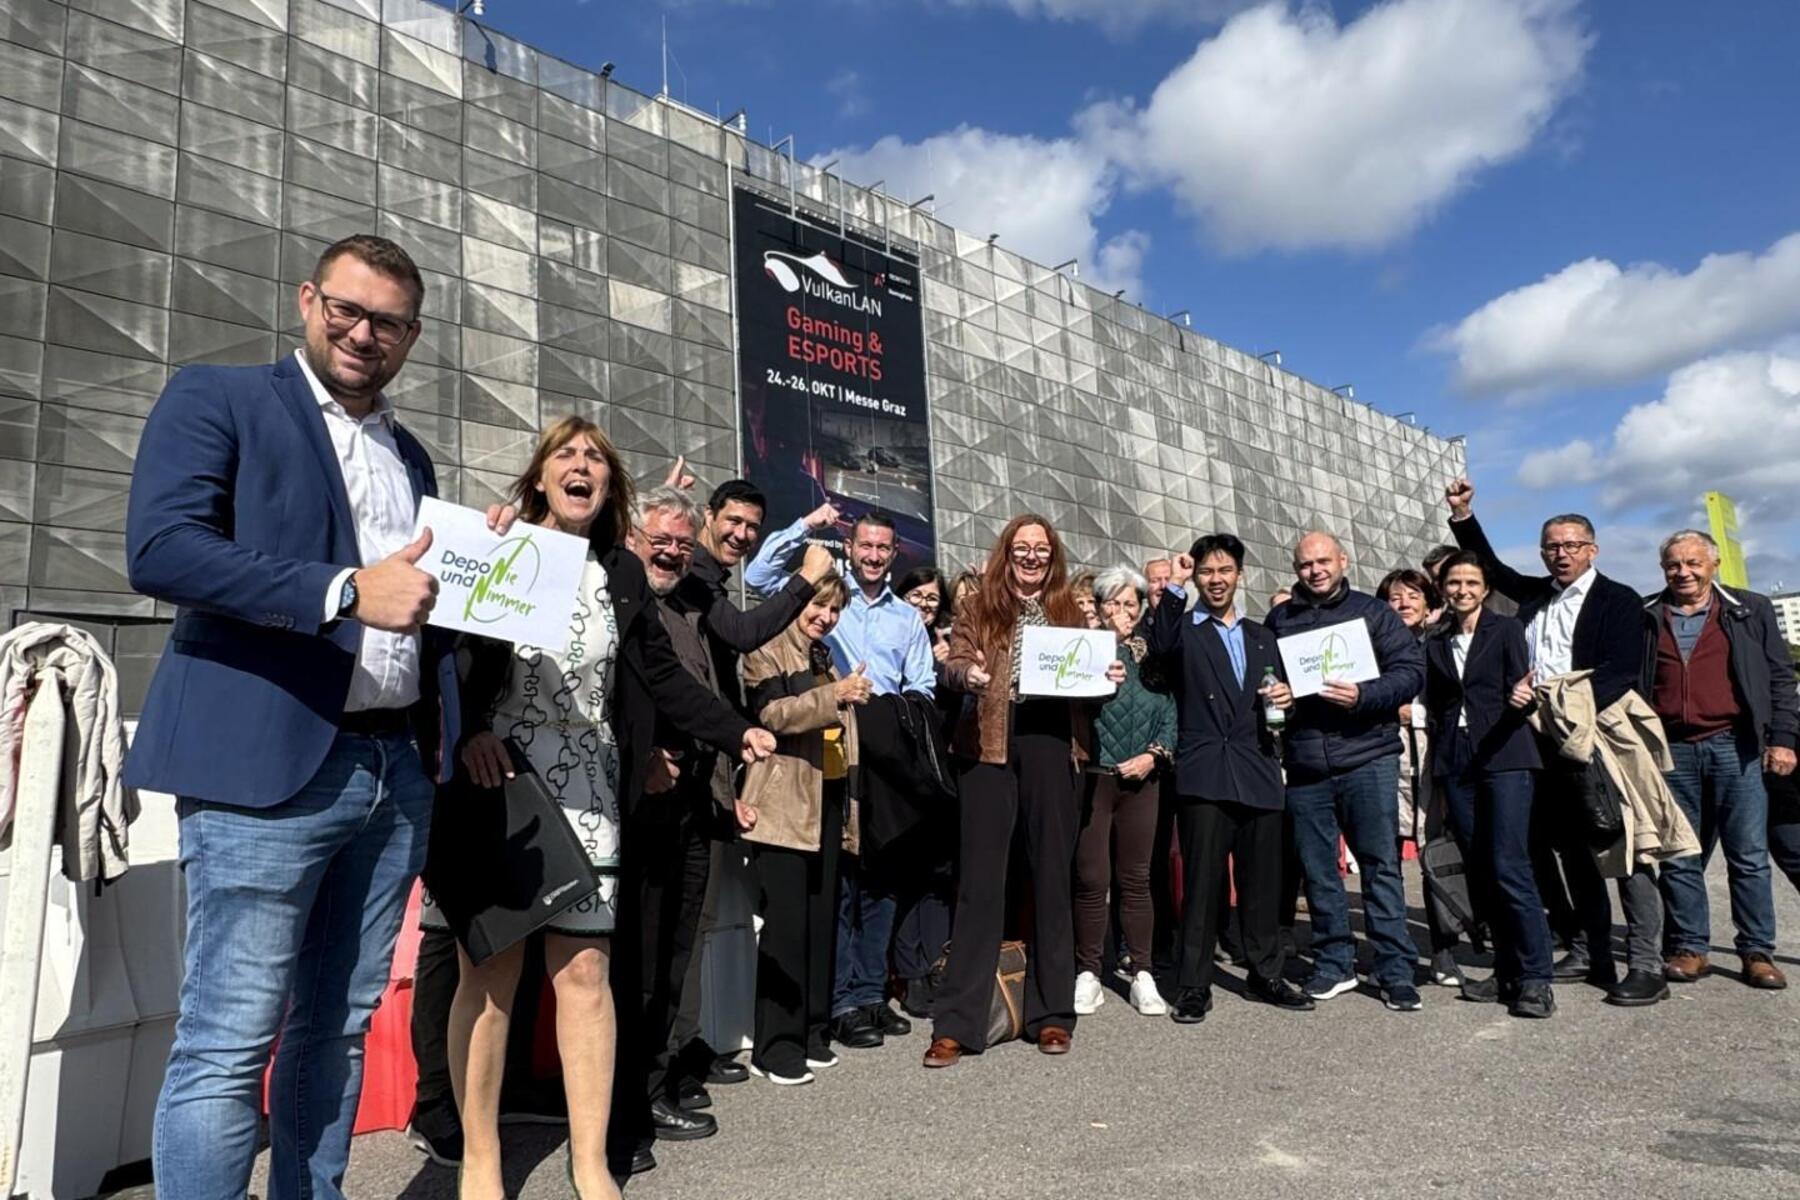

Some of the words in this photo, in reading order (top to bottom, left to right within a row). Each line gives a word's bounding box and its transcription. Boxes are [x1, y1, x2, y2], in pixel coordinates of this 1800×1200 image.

[801, 274, 882, 317] VulkanLAN
[786, 306, 863, 351] Gaming
[867, 332, 883, 355] &
[788, 336, 883, 380] ESPORTS
[767, 369, 809, 393] 24.-26.
[812, 382, 835, 399] OKT
[845, 389, 880, 410] Messe
[882, 398, 907, 416] Graz
[440, 569, 477, 588] und
